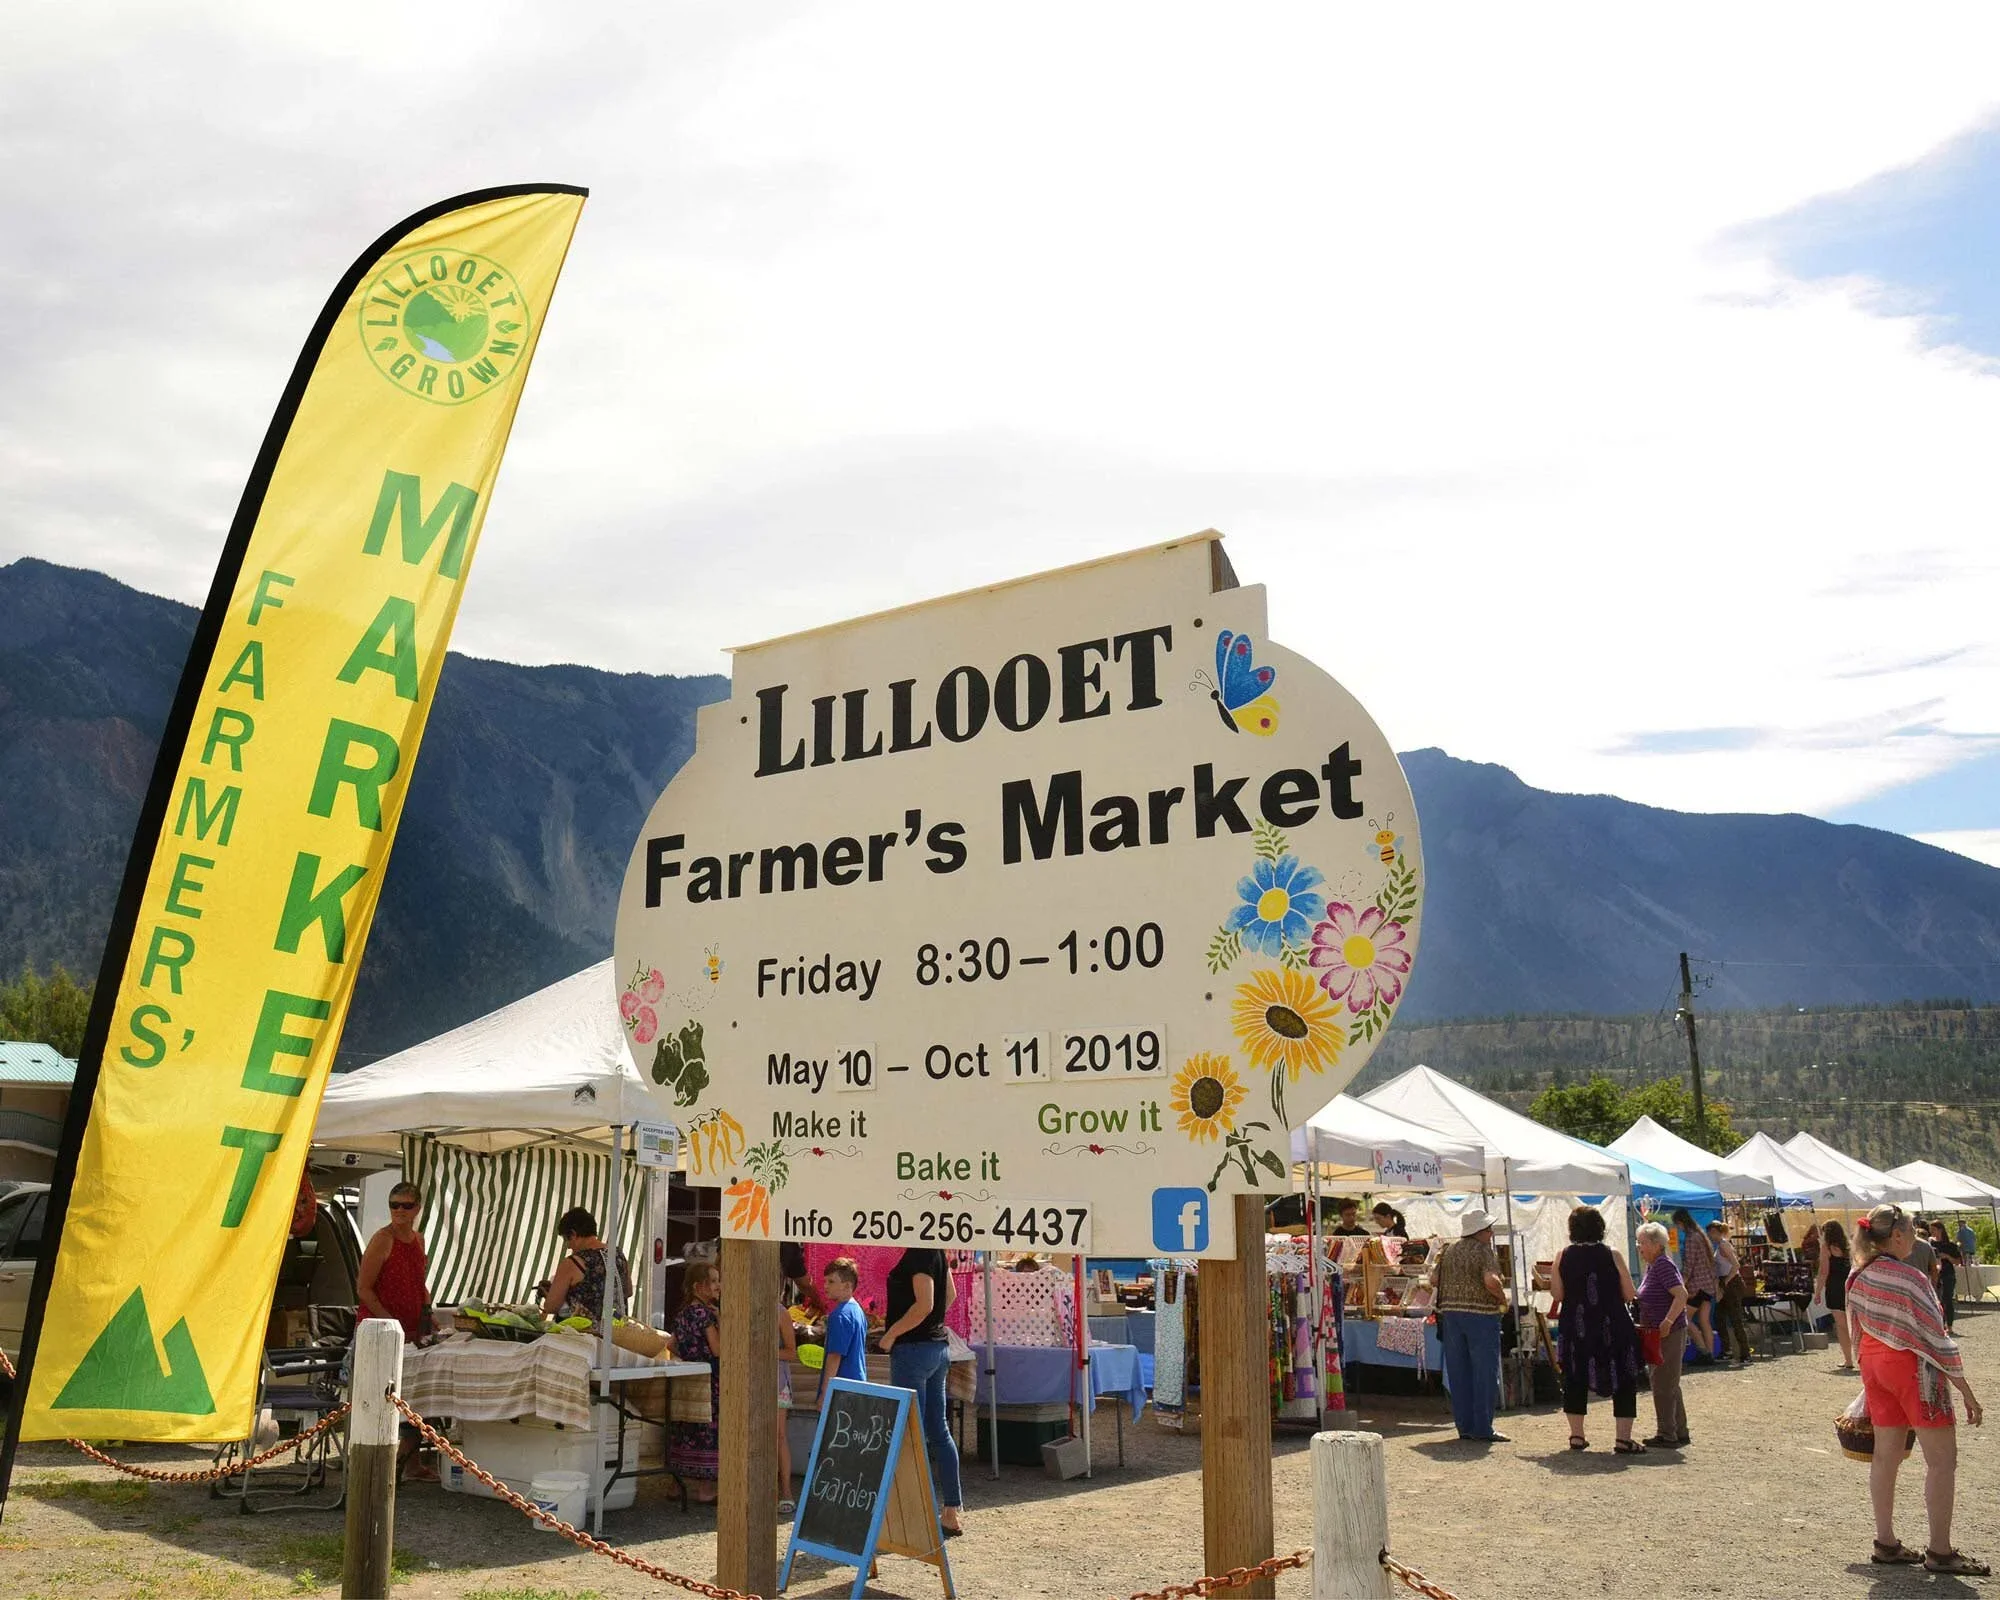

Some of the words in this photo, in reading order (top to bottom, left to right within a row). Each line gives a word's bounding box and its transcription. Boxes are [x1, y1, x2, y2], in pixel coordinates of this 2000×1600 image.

[367, 255, 517, 327] LILLOOET
[390, 340, 519, 399] GROWN
[1002, 741, 1364, 866] Market
[221, 469, 479, 1228] MARKET
[756, 953, 882, 1002] Friday
[767, 1052, 829, 1093] May
[838, 1049, 872, 1086] 10
[924, 1042, 990, 1080] Oct
[1006, 1037, 1039, 1076] 11
[1065, 1030, 1161, 1073] 2019
[773, 1111, 841, 1138] Make
[850, 1110, 868, 1138] it
[1038, 1103, 1129, 1134] Grow
[1140, 1101, 1163, 1132] it
[896, 1151, 971, 1181] Bake
[981, 1151, 1001, 1180] it
[1384, 1160, 1394, 1174] A
[1395, 1160, 1421, 1175] Special
[784, 1209, 833, 1237] Info
[812, 1457, 878, 1513] Garden
